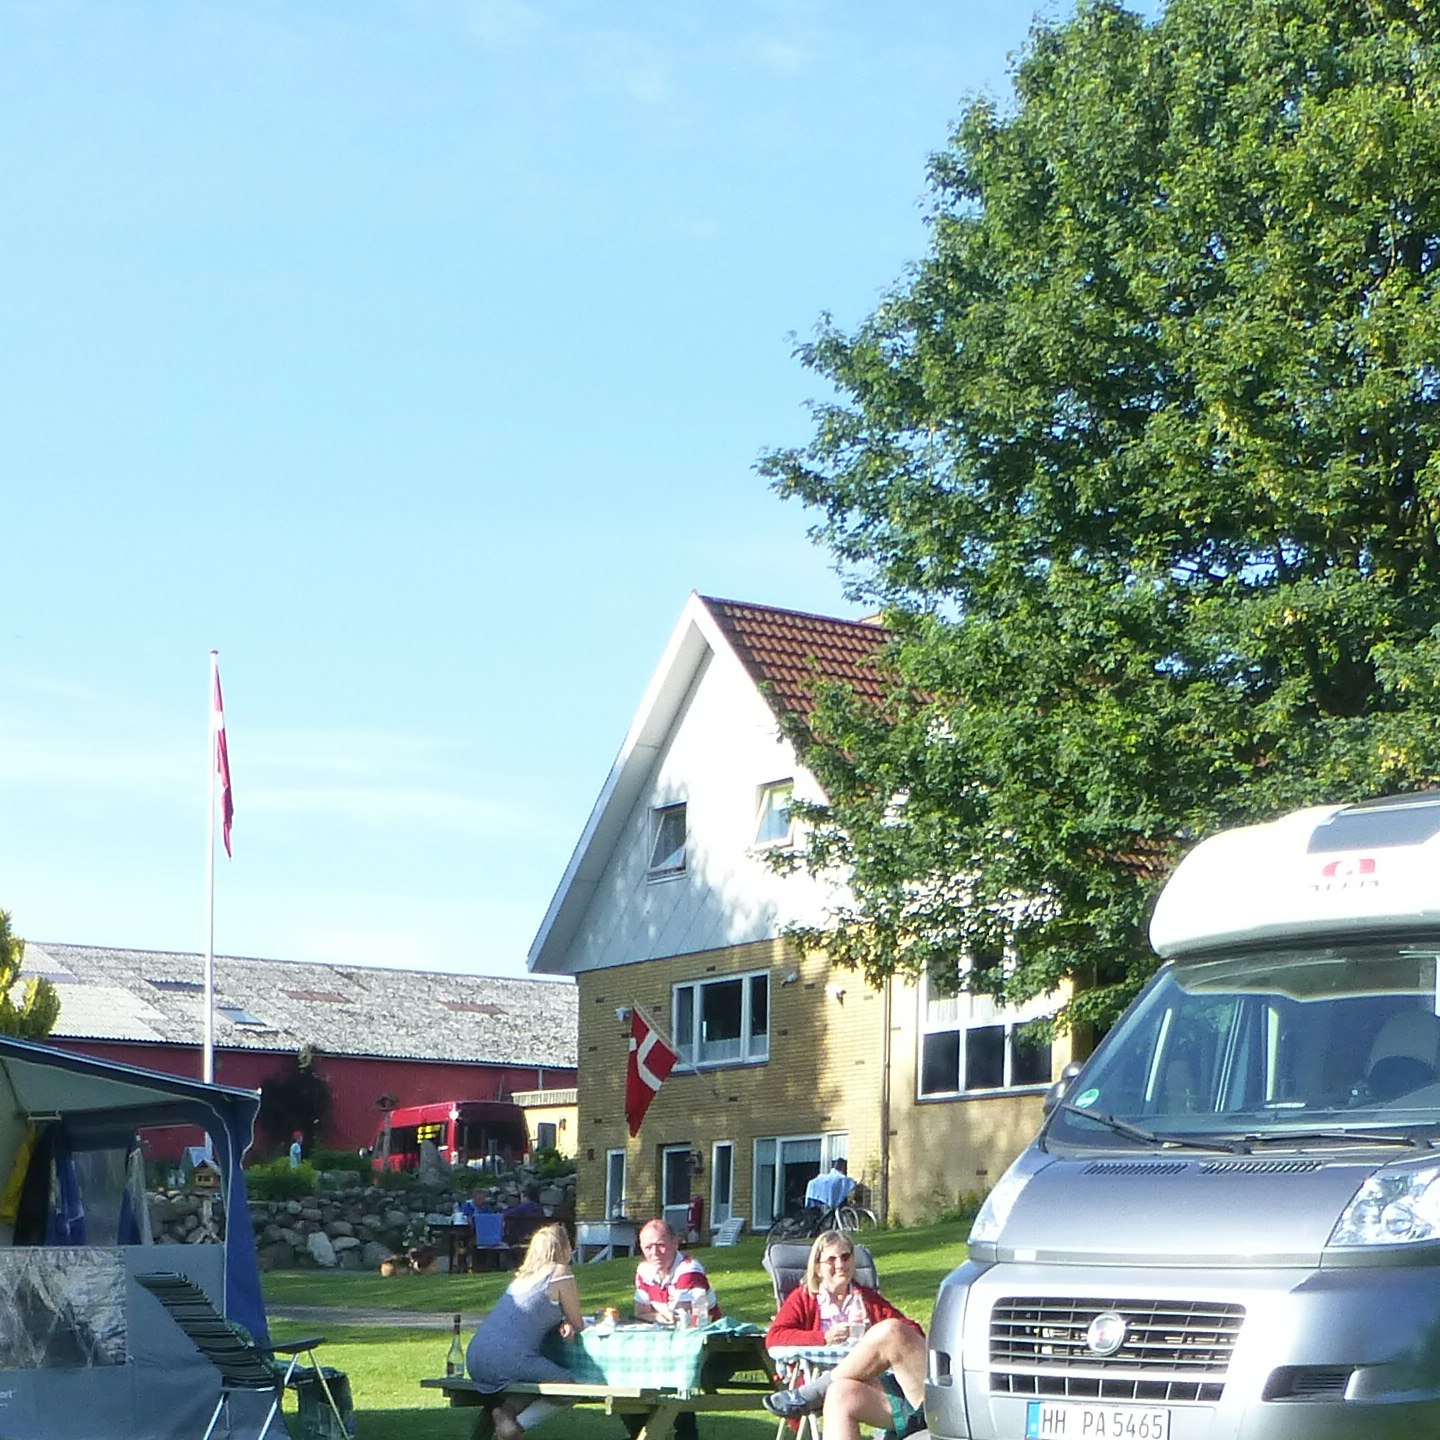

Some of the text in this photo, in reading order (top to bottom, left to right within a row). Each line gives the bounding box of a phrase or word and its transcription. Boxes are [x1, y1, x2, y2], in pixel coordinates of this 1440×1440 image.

[1042, 1409, 1164, 1440] HH PA 5465
